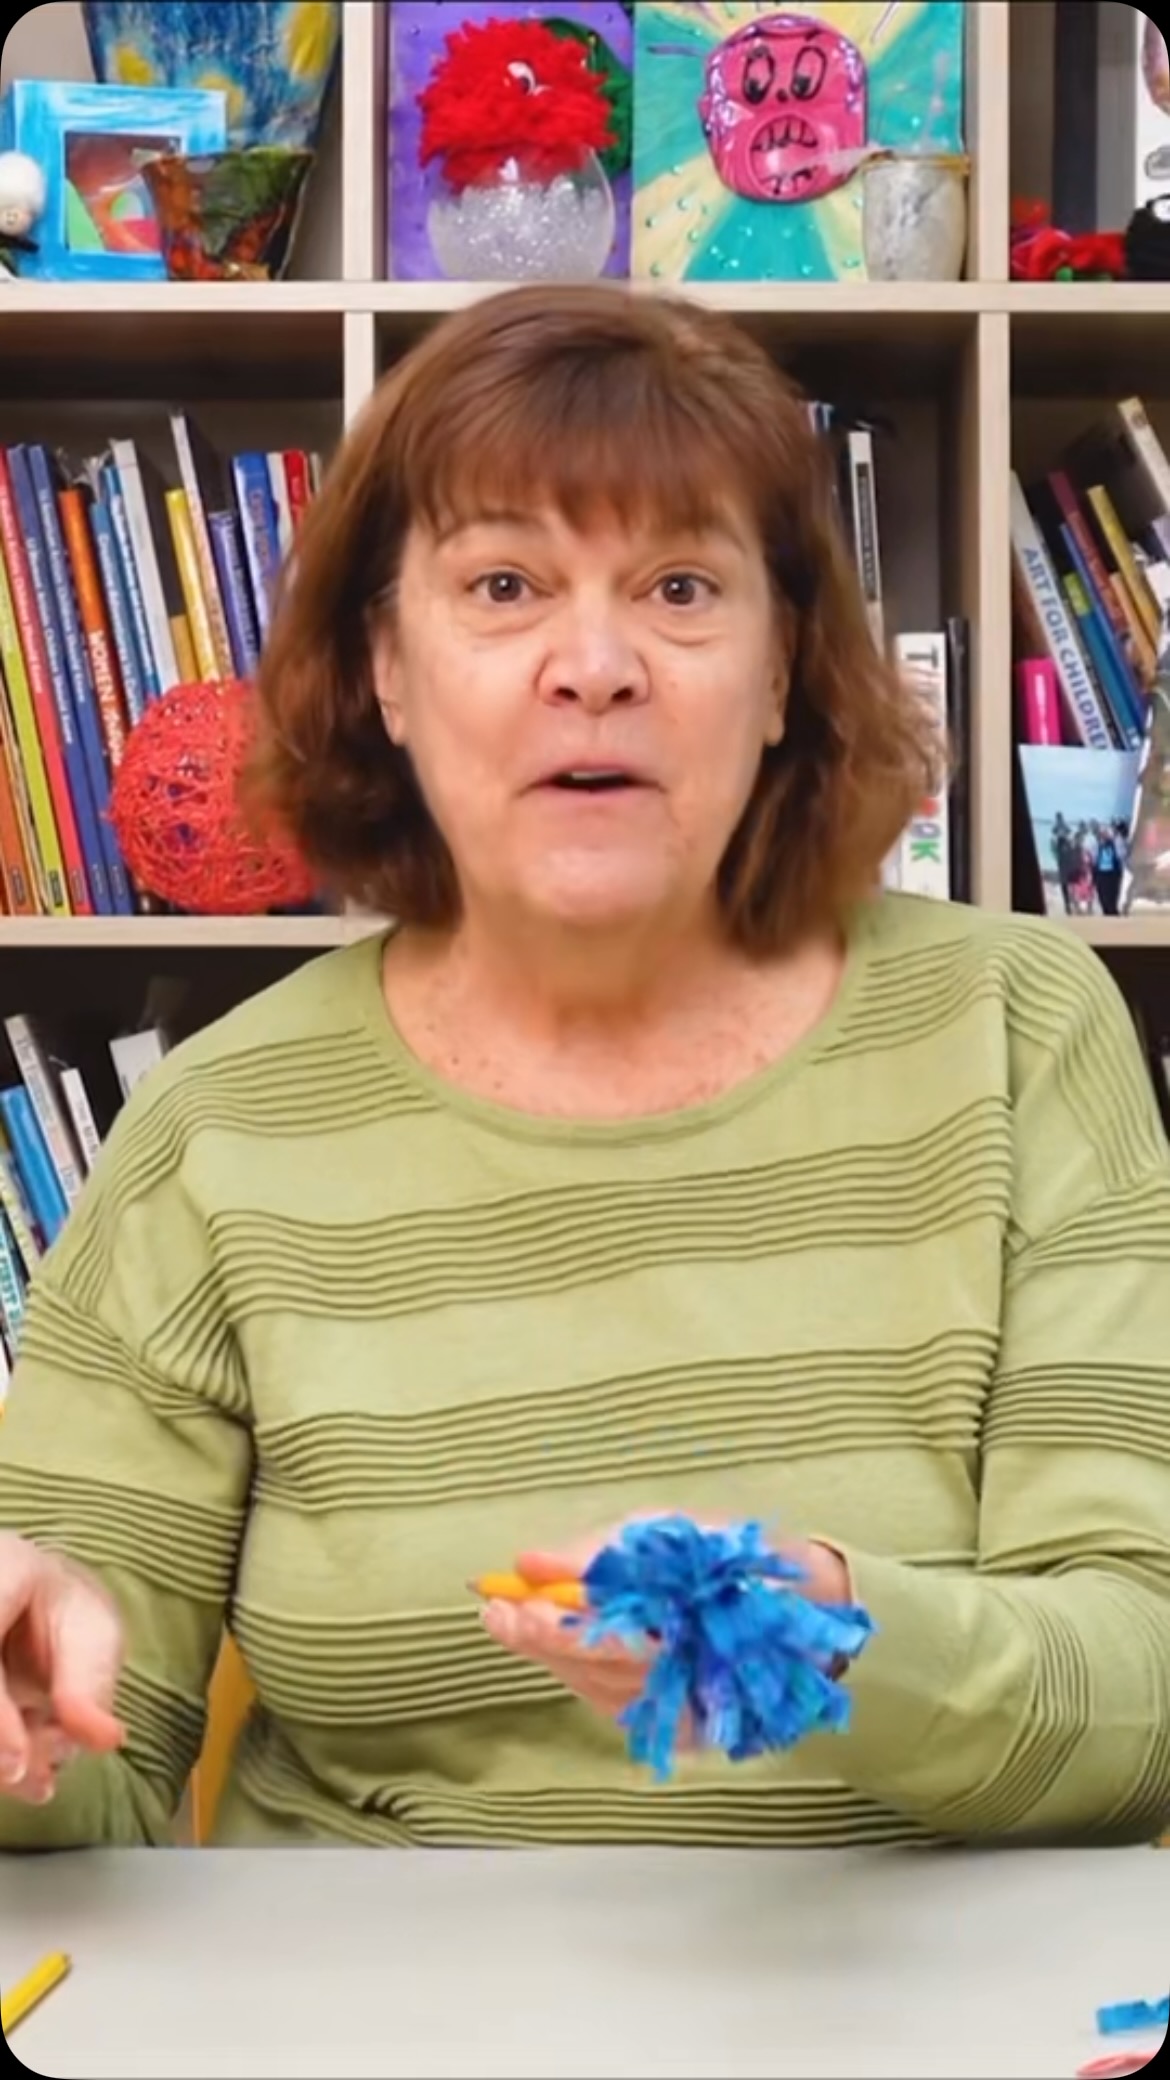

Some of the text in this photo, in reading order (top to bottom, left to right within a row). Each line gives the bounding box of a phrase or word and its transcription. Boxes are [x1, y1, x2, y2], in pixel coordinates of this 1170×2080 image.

[1020, 544, 1053, 597] ART
[1039, 595, 1070, 644] FOR
[85, 628, 118, 704] WOMEN
